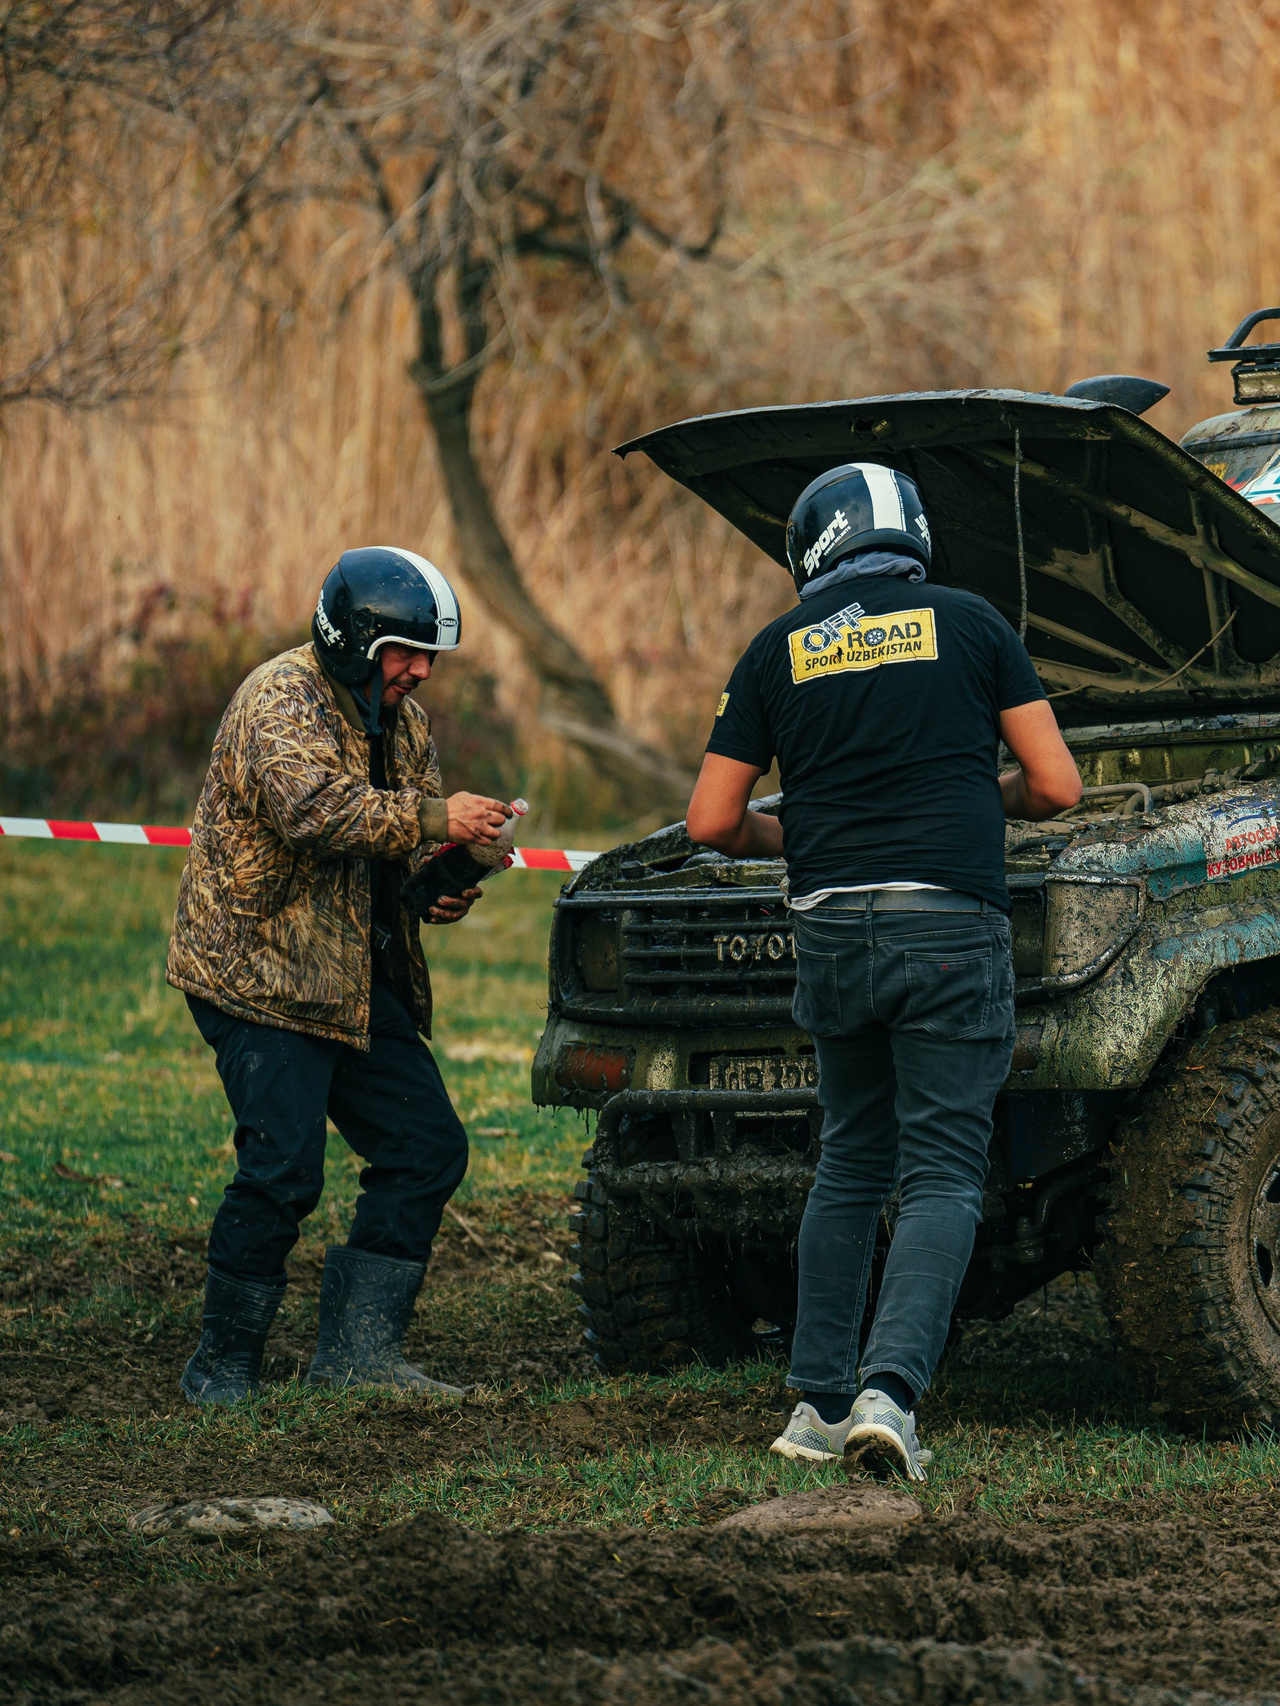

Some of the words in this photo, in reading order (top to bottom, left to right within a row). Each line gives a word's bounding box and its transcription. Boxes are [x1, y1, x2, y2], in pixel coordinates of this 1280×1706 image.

[803, 509, 849, 577] Sport
[801, 602, 866, 654] OFF
[847, 621, 922, 649] ROAD
[805, 652, 845, 671] SPORT
[846, 640, 922, 662] UZBEKISTAN
[713, 932, 798, 961] TOYOT
